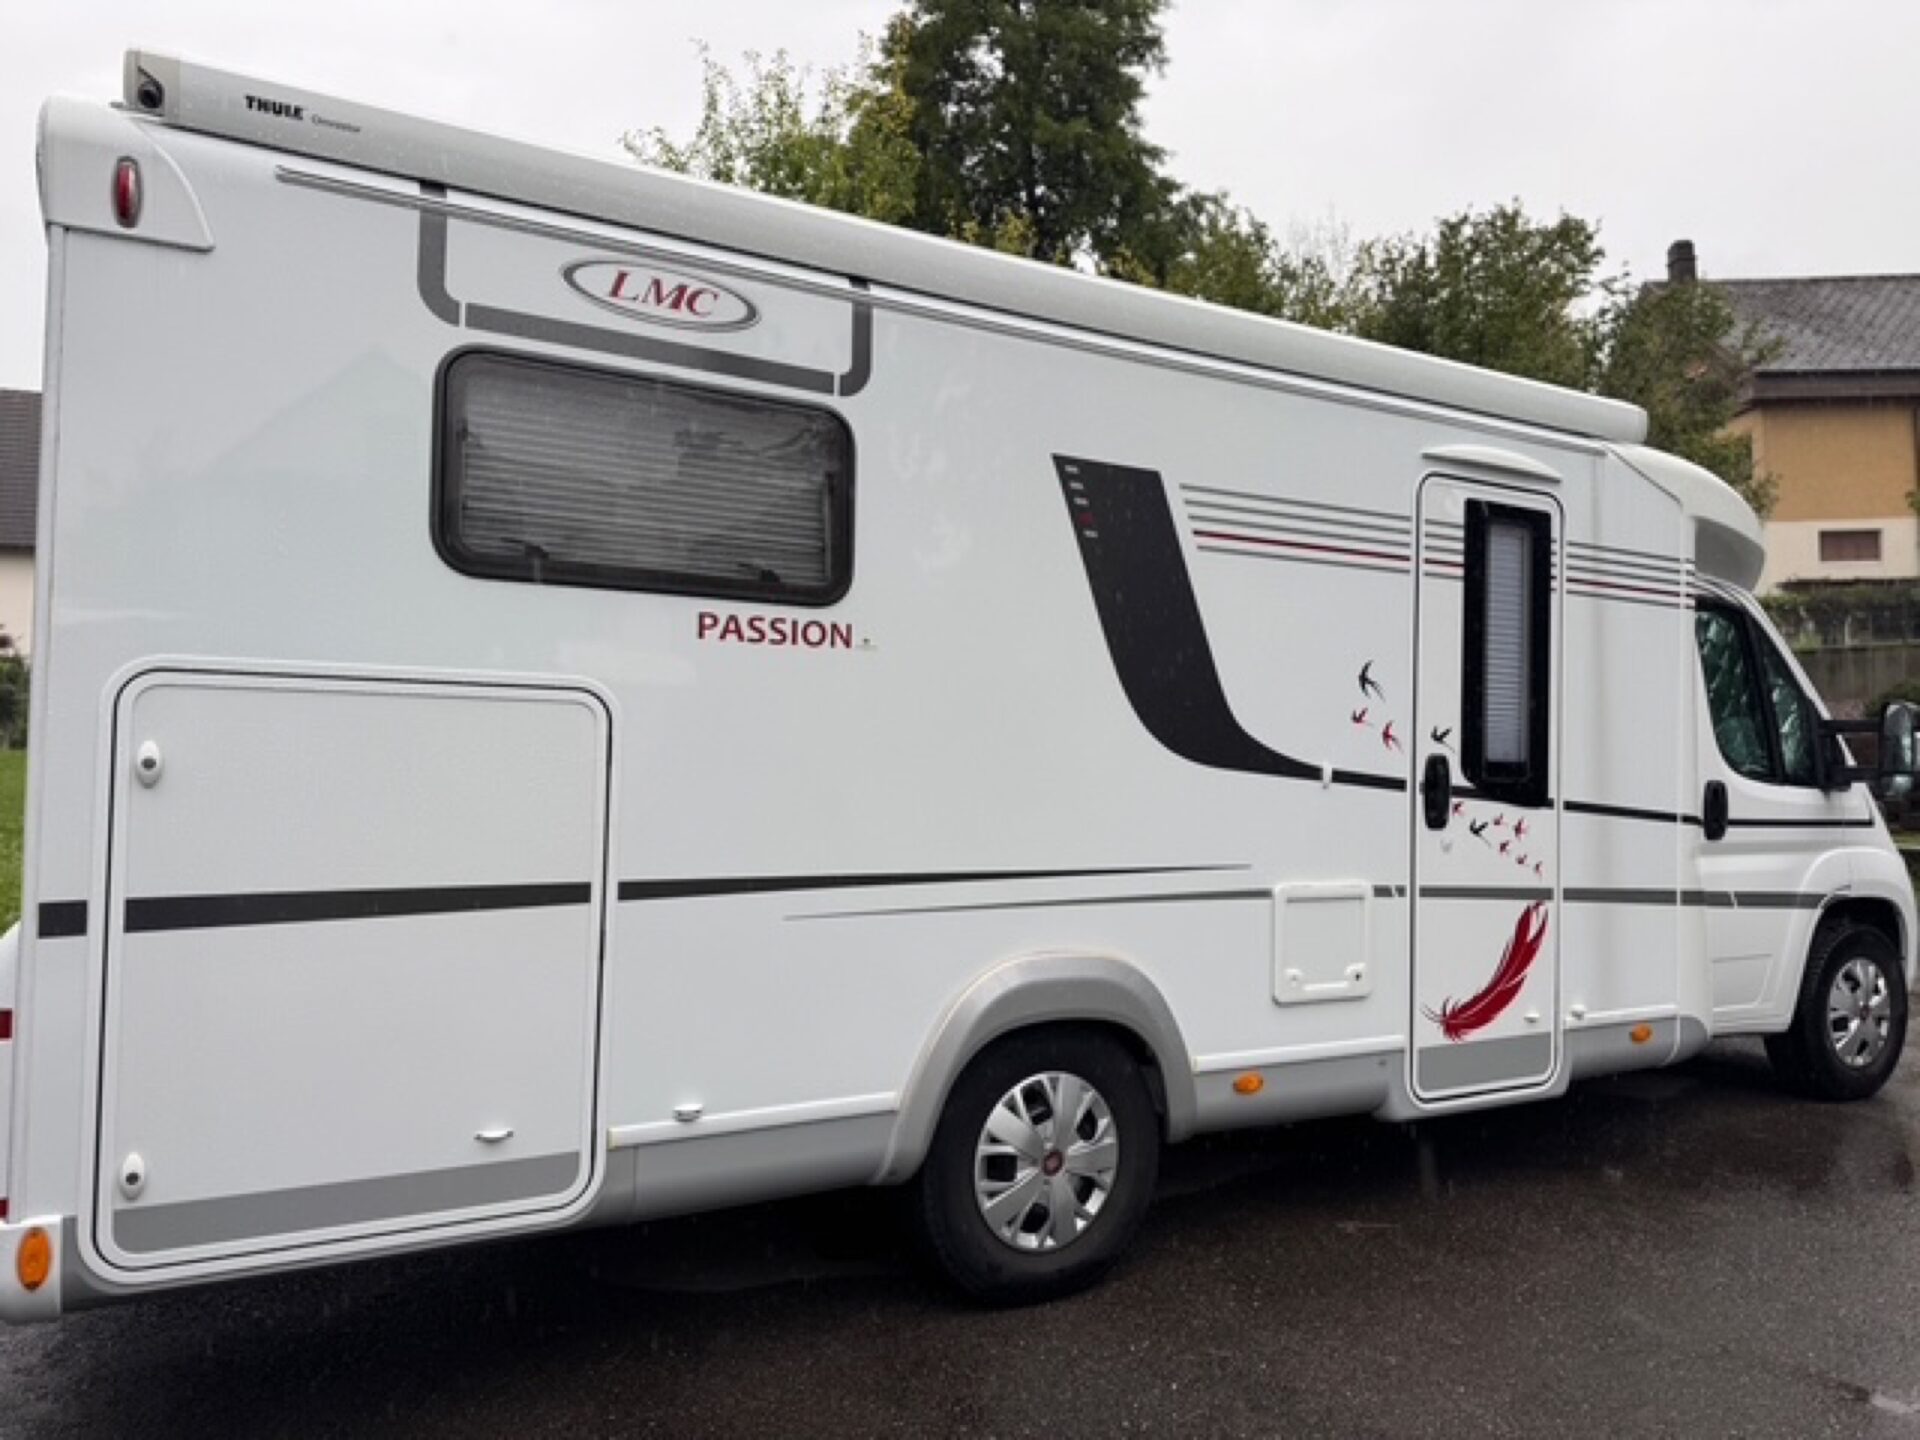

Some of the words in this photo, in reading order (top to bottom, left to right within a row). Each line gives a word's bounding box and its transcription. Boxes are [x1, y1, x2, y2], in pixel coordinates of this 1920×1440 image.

[245, 94, 304, 121] THULE
[609, 270, 719, 317] LMC
[698, 611, 853, 649] PASSION
